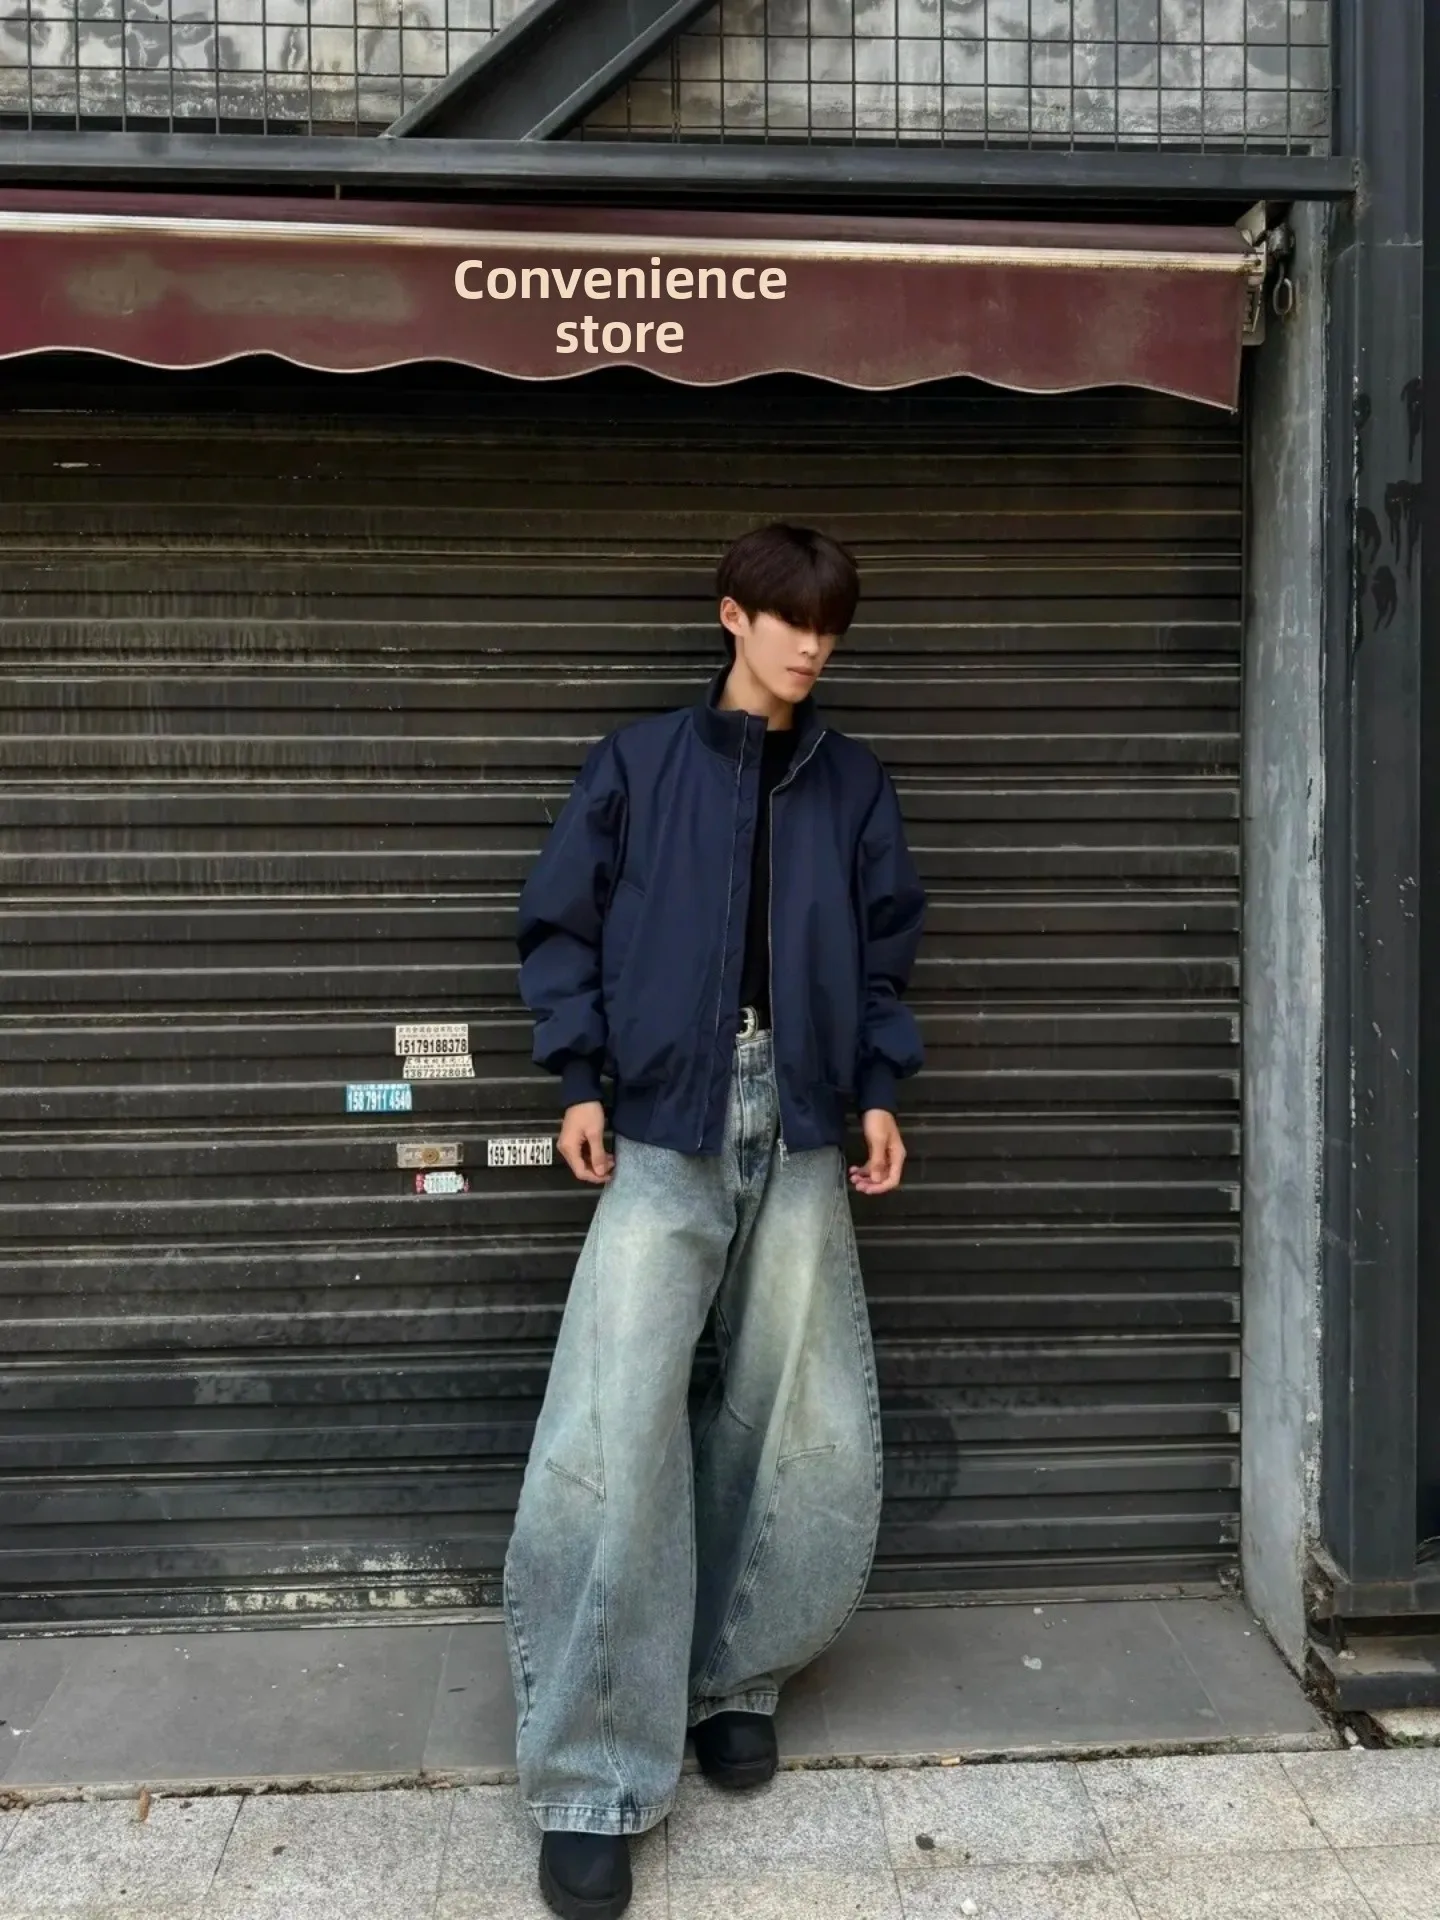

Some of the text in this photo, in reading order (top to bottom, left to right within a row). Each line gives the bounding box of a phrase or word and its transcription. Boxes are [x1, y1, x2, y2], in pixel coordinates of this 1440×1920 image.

[454, 256, 788, 300] Convenience
[556, 315, 685, 354] store
[398, 1038, 467, 1054] 15179188378
